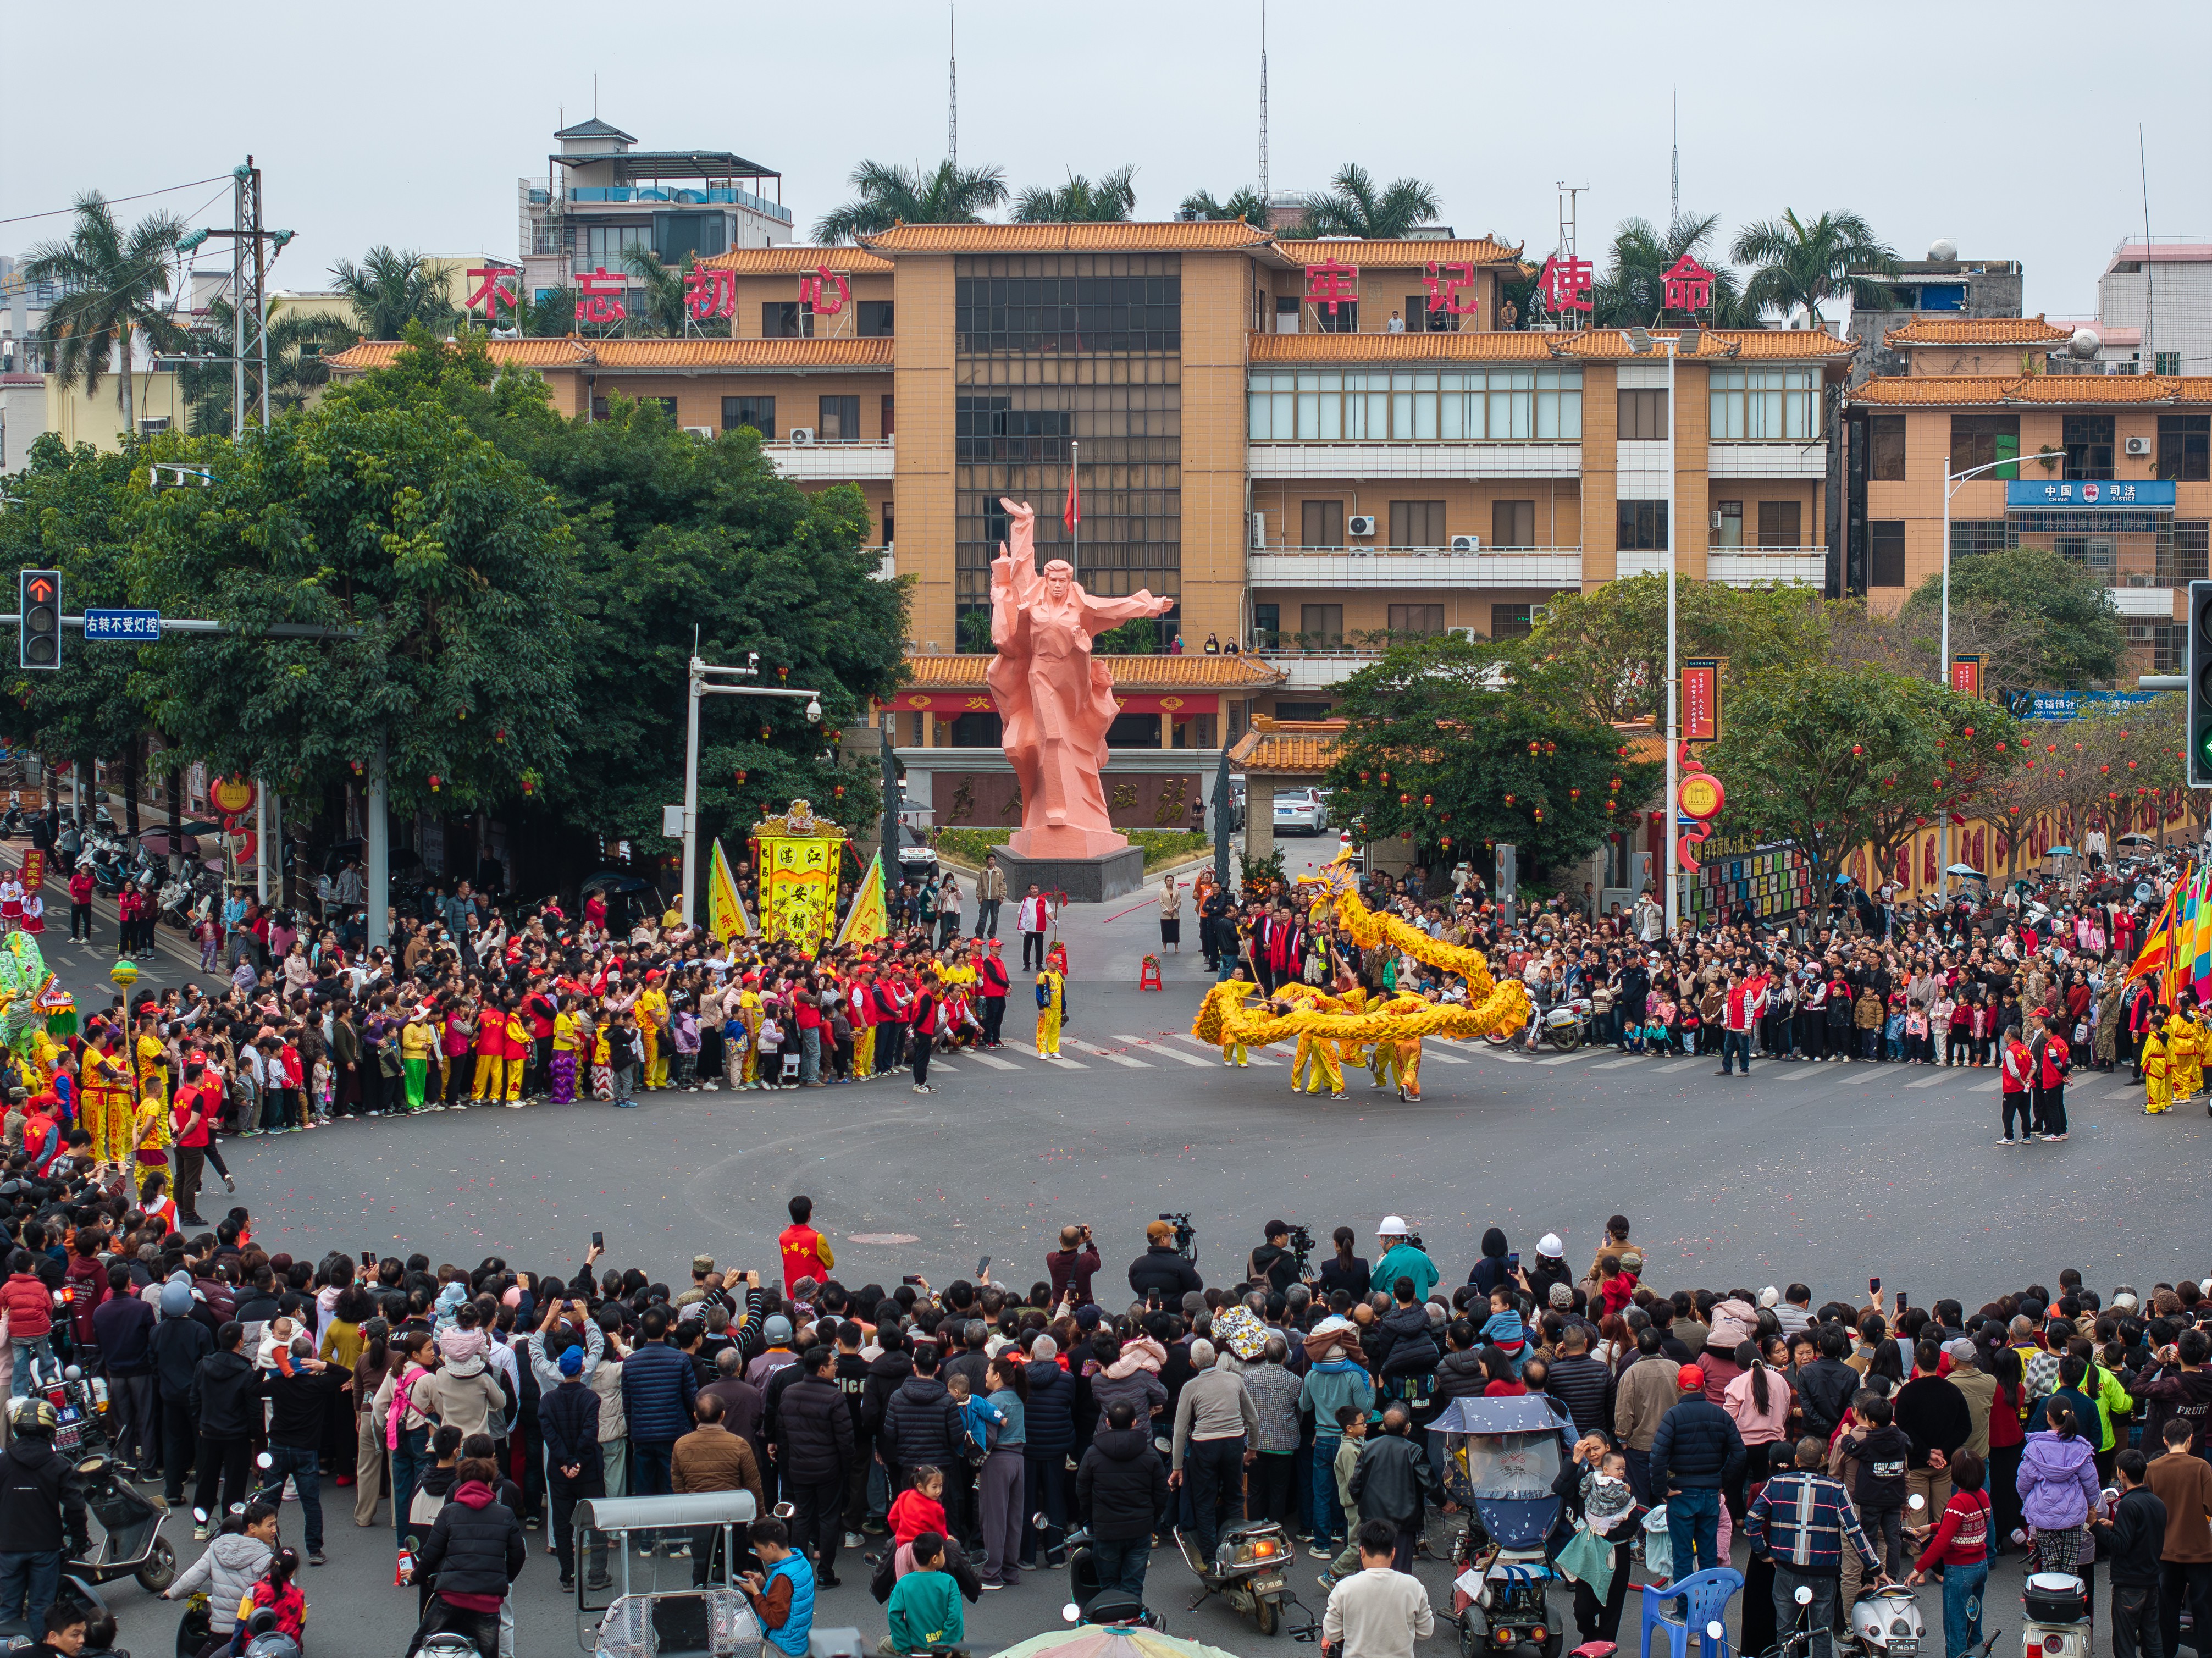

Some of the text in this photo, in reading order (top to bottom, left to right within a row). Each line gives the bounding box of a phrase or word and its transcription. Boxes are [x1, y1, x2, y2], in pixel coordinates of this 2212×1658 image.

[465, 264, 851, 323] 不忘初心
[1304, 255, 1716, 316] 牢记使命
[2045, 485, 2136, 496] 中国 司法
[87, 616, 157, 633] 右转不受灯控
[781, 847, 822, 864] 湛江
